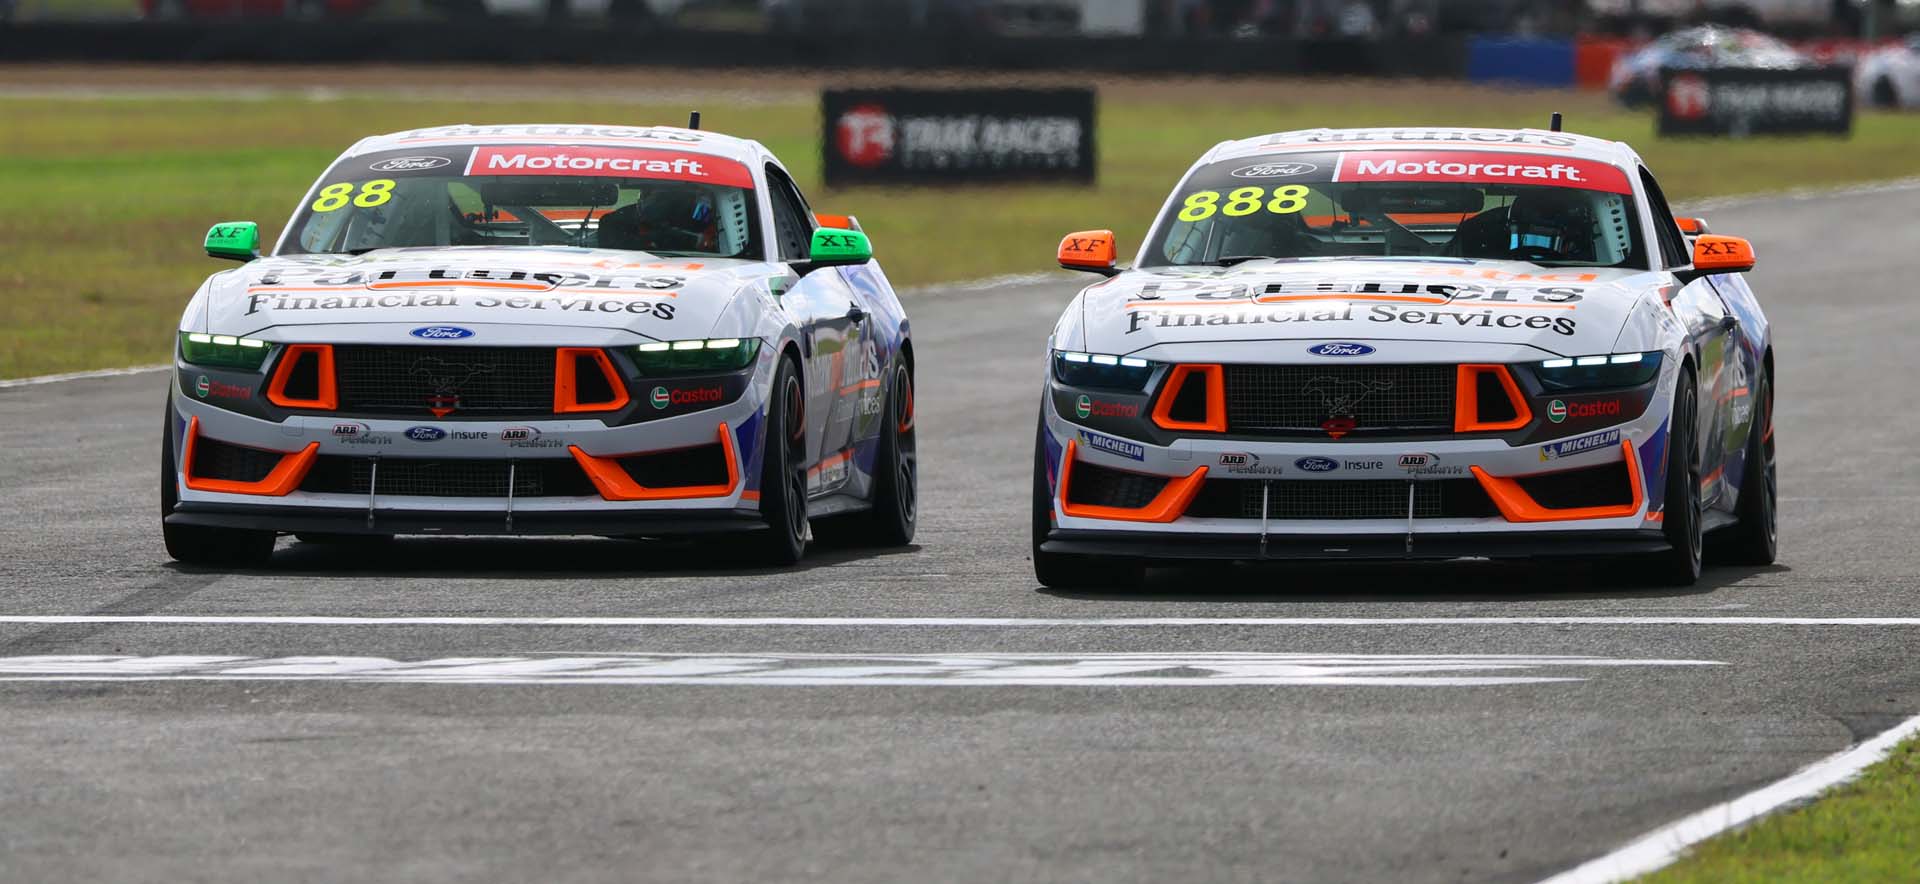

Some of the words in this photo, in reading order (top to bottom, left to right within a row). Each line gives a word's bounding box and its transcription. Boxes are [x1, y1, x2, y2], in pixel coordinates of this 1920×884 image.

[380, 157, 440, 170] Ford
[488, 153, 704, 176] Motorcraft
[1241, 162, 1306, 177] Ford
[1356, 159, 1581, 181] Motorcraft
[312, 179, 396, 212] 88
[1178, 184, 1309, 222] 888
[1064, 238, 1105, 251] XF
[244, 292, 459, 316] Financial
[475, 294, 676, 321] Services
[1125, 304, 1353, 335] Financial
[1368, 304, 1578, 337] Services
[417, 326, 468, 339] Ford
[1315, 343, 1366, 356] Ford
[671, 384, 723, 404] Castrol
[1091, 400, 1139, 417] Castrol
[1567, 400, 1620, 417] Castrol
[409, 427, 441, 441] Ford
[450, 429, 488, 440] Insure
[503, 430, 527, 439] ARB
[1560, 429, 1619, 453] MICHELIN
[1092, 435, 1143, 457] MICHELIN
[1221, 455, 1245, 464] ARB
[1301, 457, 1334, 472] Ford
[1344, 459, 1383, 470] Insure
[1401, 456, 1426, 465] ARB
